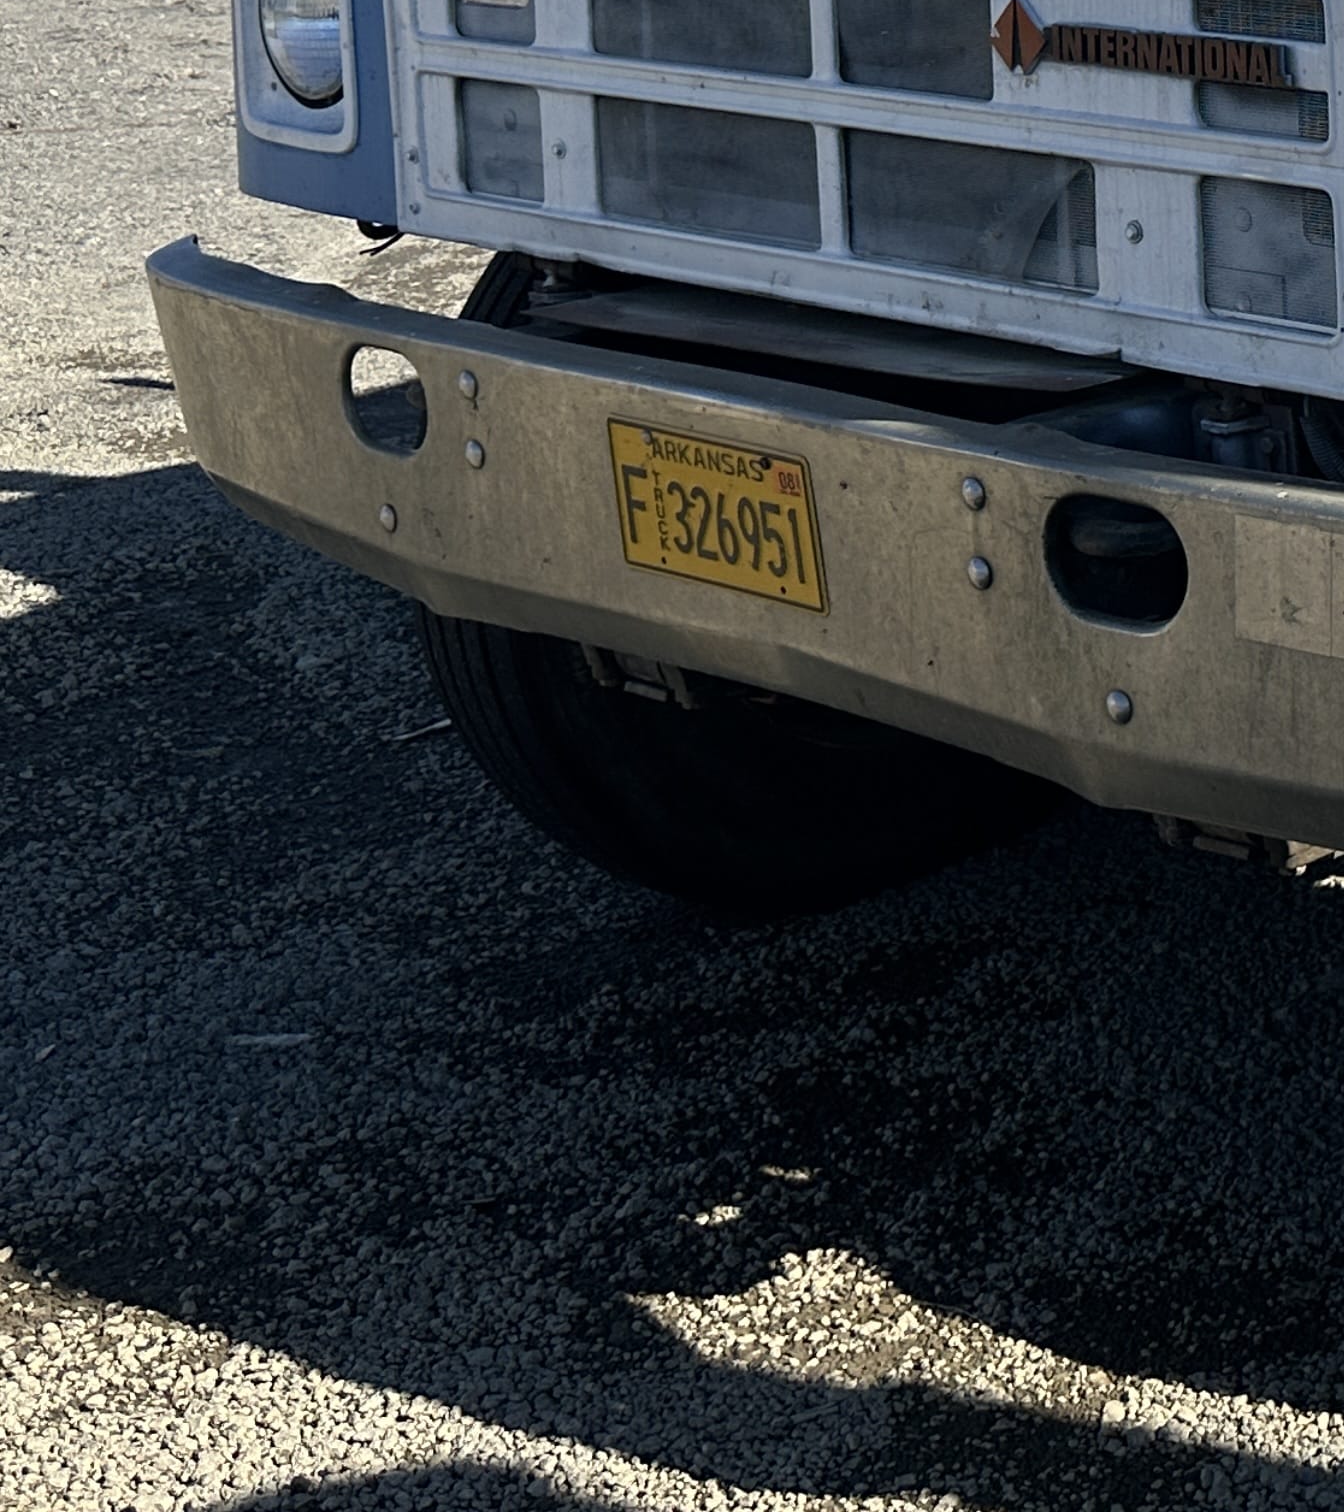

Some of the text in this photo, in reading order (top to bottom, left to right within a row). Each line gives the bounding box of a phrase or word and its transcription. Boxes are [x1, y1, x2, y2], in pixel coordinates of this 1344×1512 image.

[1049, 25, 1288, 88] INTERNATIONAL
[651, 439, 765, 483] ARKANSAS
[621, 464, 647, 544] F
[652, 470, 671, 552] TRUCK
[666, 480, 806, 585] 326951
